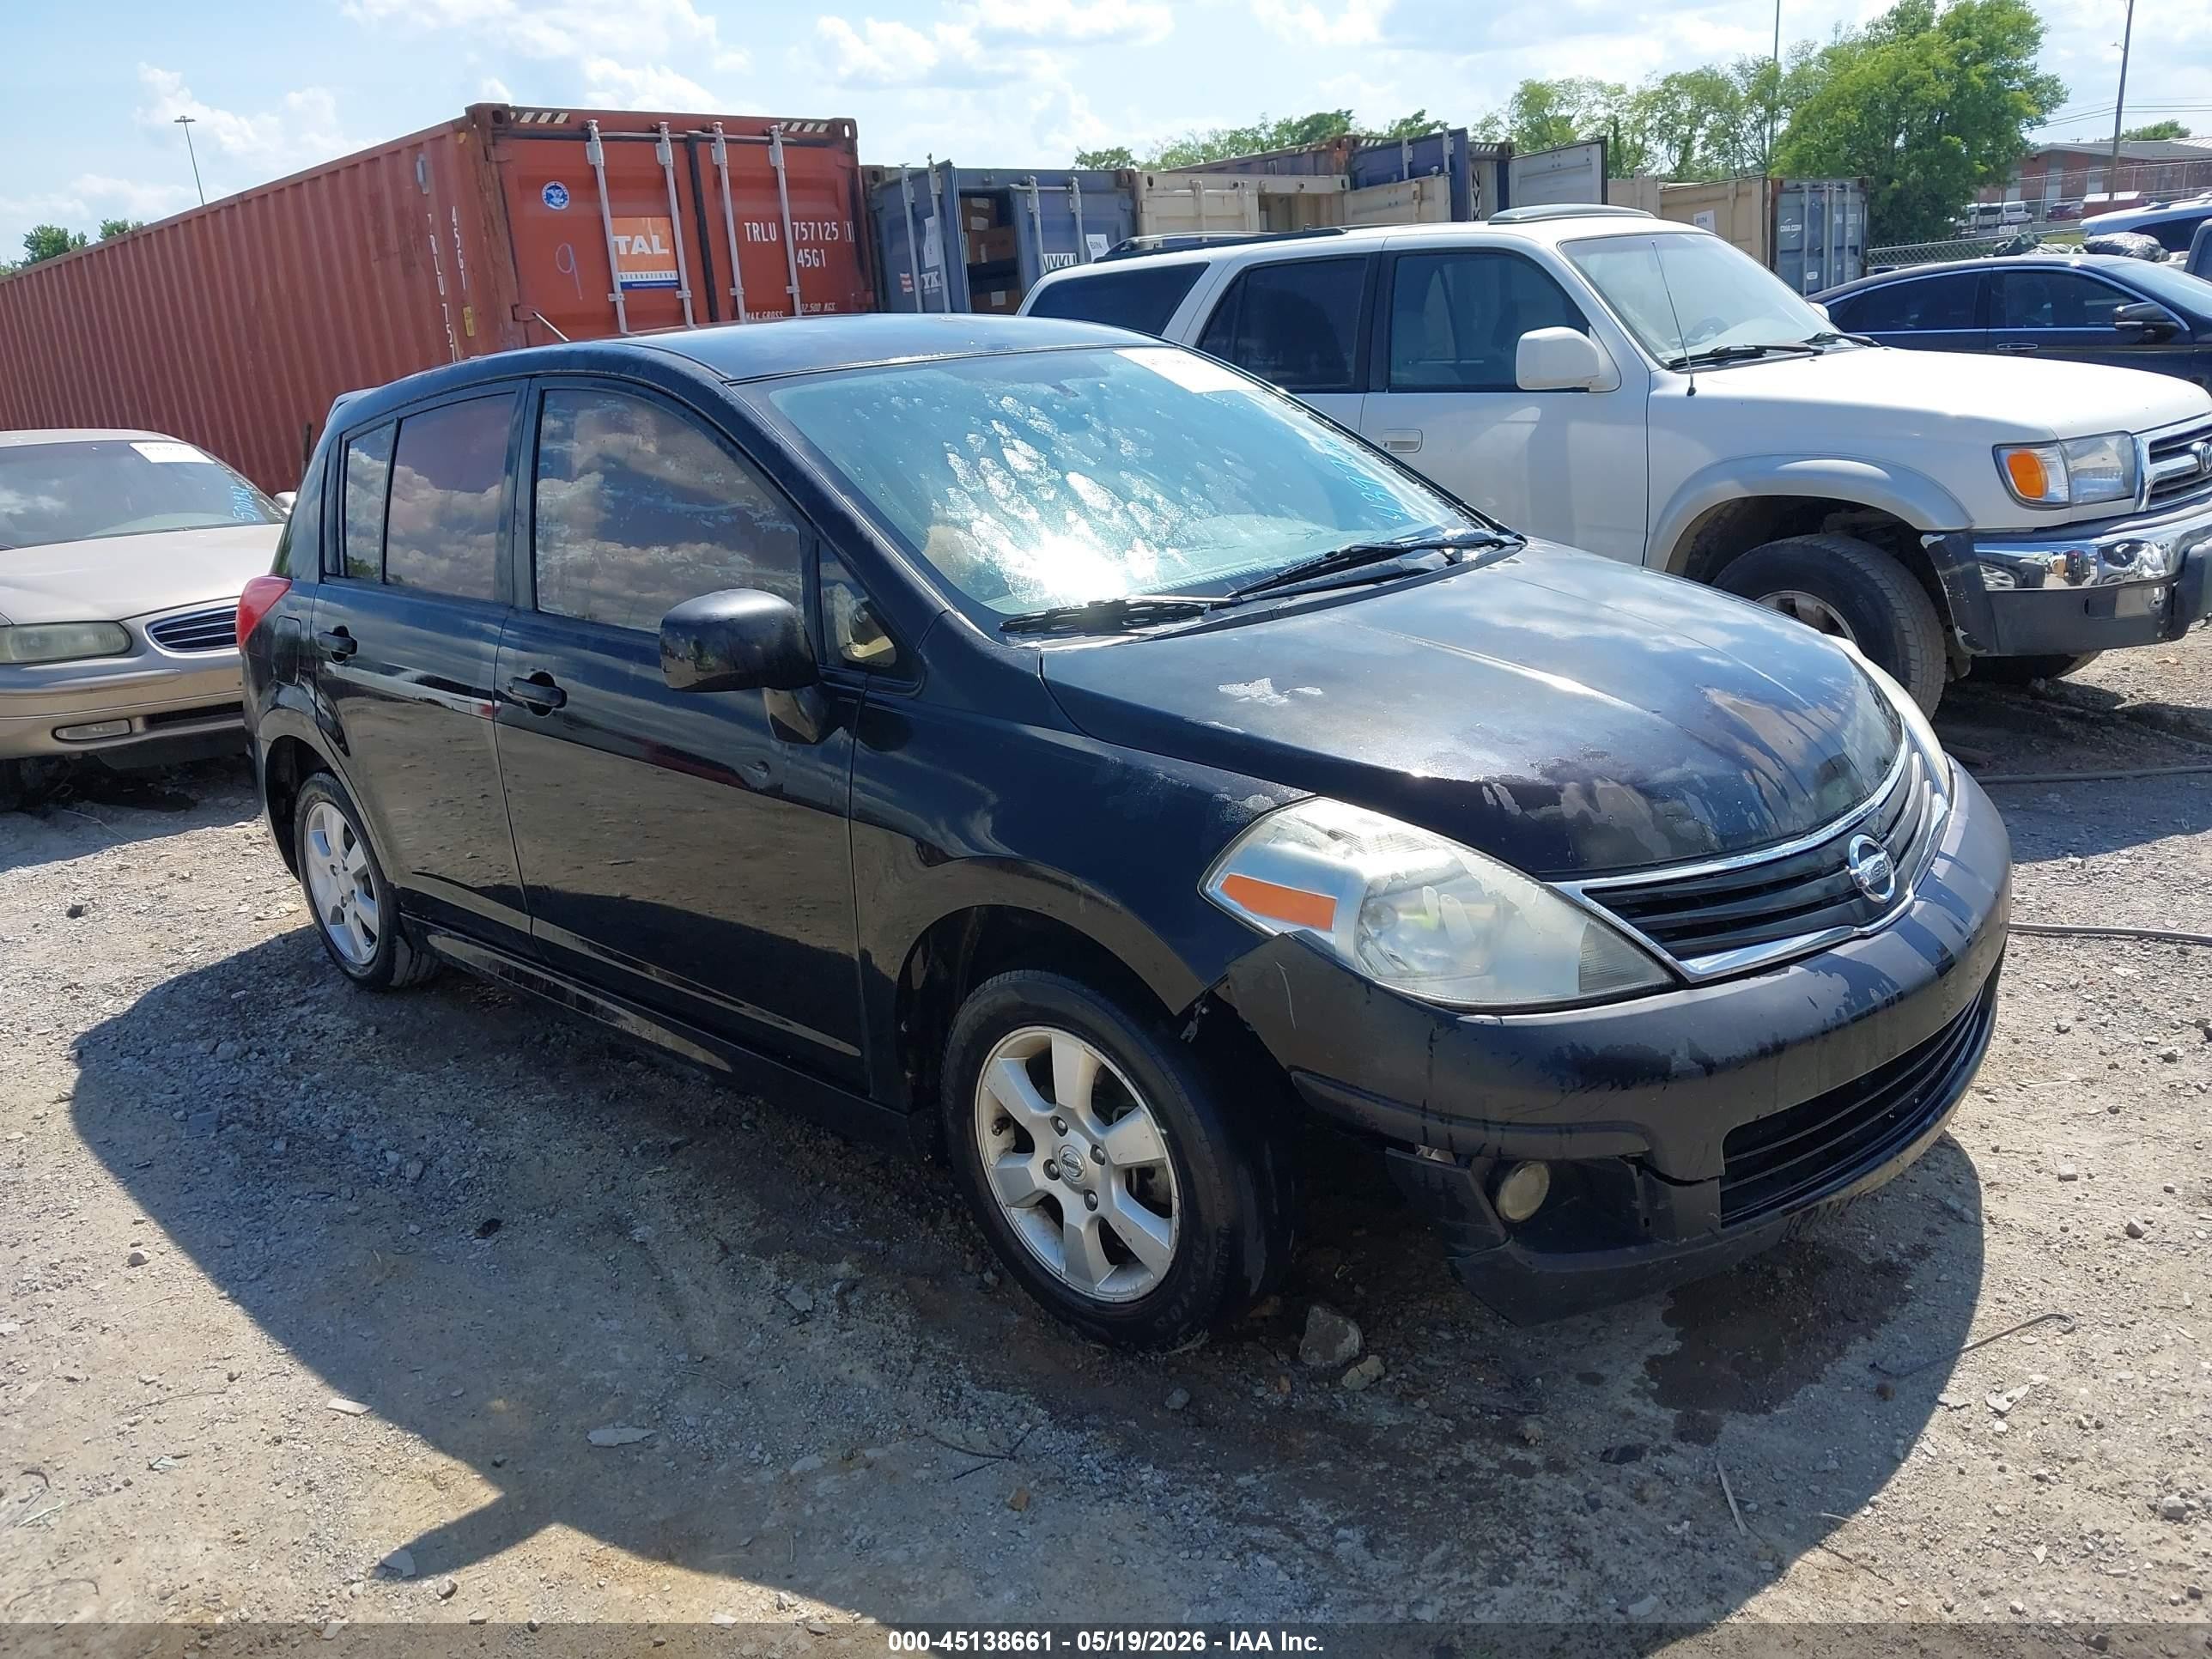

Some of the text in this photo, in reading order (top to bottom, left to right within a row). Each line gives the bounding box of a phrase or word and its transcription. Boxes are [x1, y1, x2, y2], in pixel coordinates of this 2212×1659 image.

[744, 222, 777, 242] TRLU
[792, 222, 839, 241] 757125
[612, 235, 669, 255] TAL
[796, 248, 826, 268] 45G1
[619, 272, 678, 281] NTERNATIONAL
